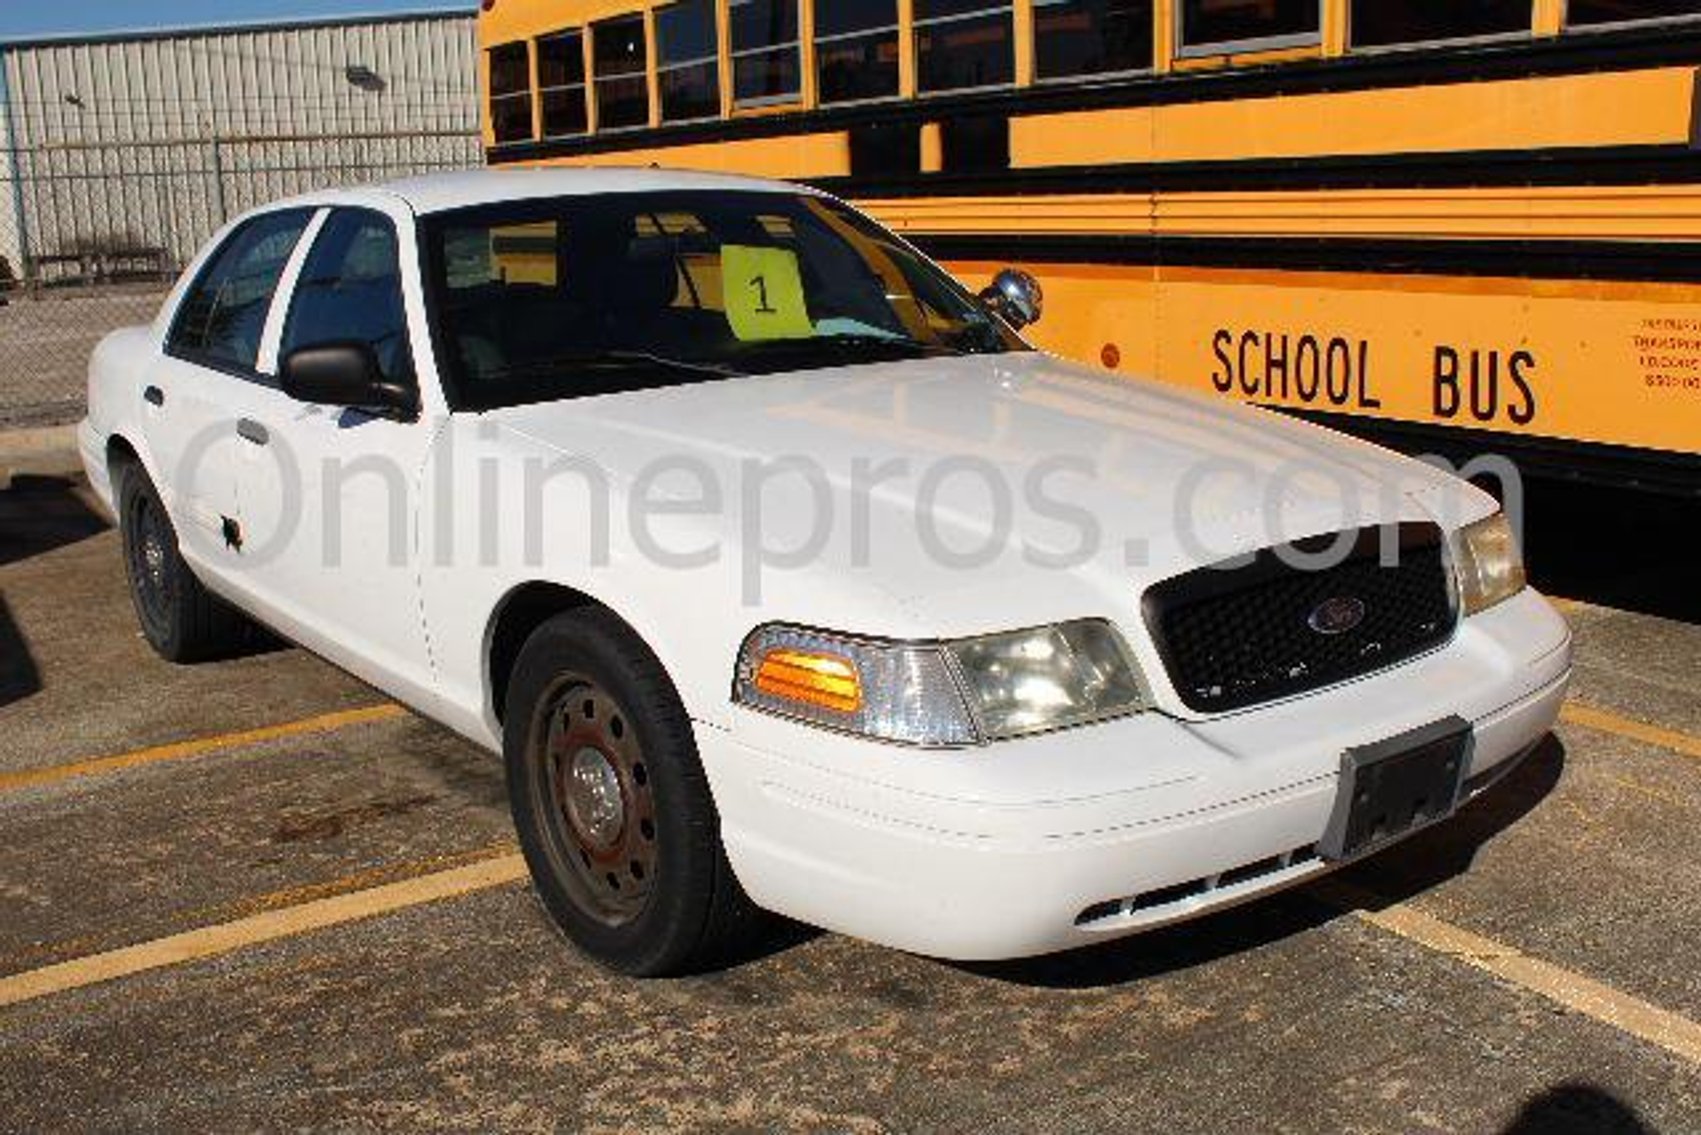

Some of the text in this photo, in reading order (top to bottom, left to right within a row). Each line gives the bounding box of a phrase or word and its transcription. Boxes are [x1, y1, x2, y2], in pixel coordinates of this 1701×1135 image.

[749, 276, 777, 313] 1
[1212, 329, 1536, 425] SCHOOL BUS
